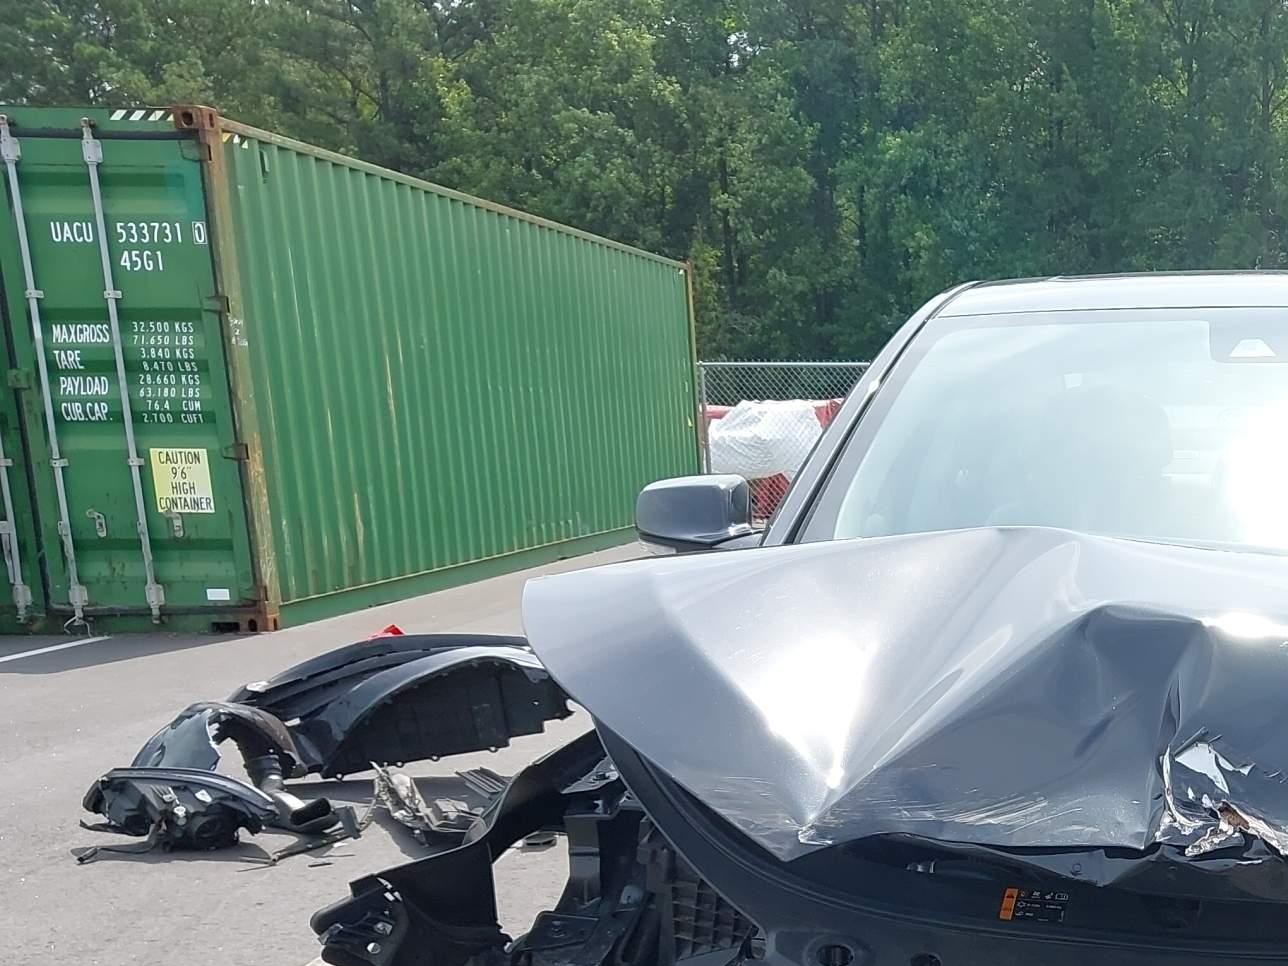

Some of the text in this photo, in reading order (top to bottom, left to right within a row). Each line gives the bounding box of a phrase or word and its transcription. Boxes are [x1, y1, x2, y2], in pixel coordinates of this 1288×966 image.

[50, 222, 206, 243] UACU 533731 0
[120, 251, 163, 271] 45G1
[132, 321, 194, 333] 32.500 KGS
[52, 324, 110, 343] MAXGROSS
[133, 335, 194, 345] 71.650 LBS
[53, 350, 85, 369] TARE
[140, 348, 195, 359] 3.840 KGS
[178, 361, 198, 372] LBS
[60, 376, 109, 395] PAYLOAD
[139, 374, 200, 385] 28.660 KGS
[181, 387, 201, 398] LBS
[146, 400, 201, 411] 76.4 CUM
[142, 413, 204, 424] 2.700 CUFT
[158, 451, 201, 464] CAUTION
[171, 481, 196, 495] HIGH
[159, 496, 213, 511] CONTAINER
